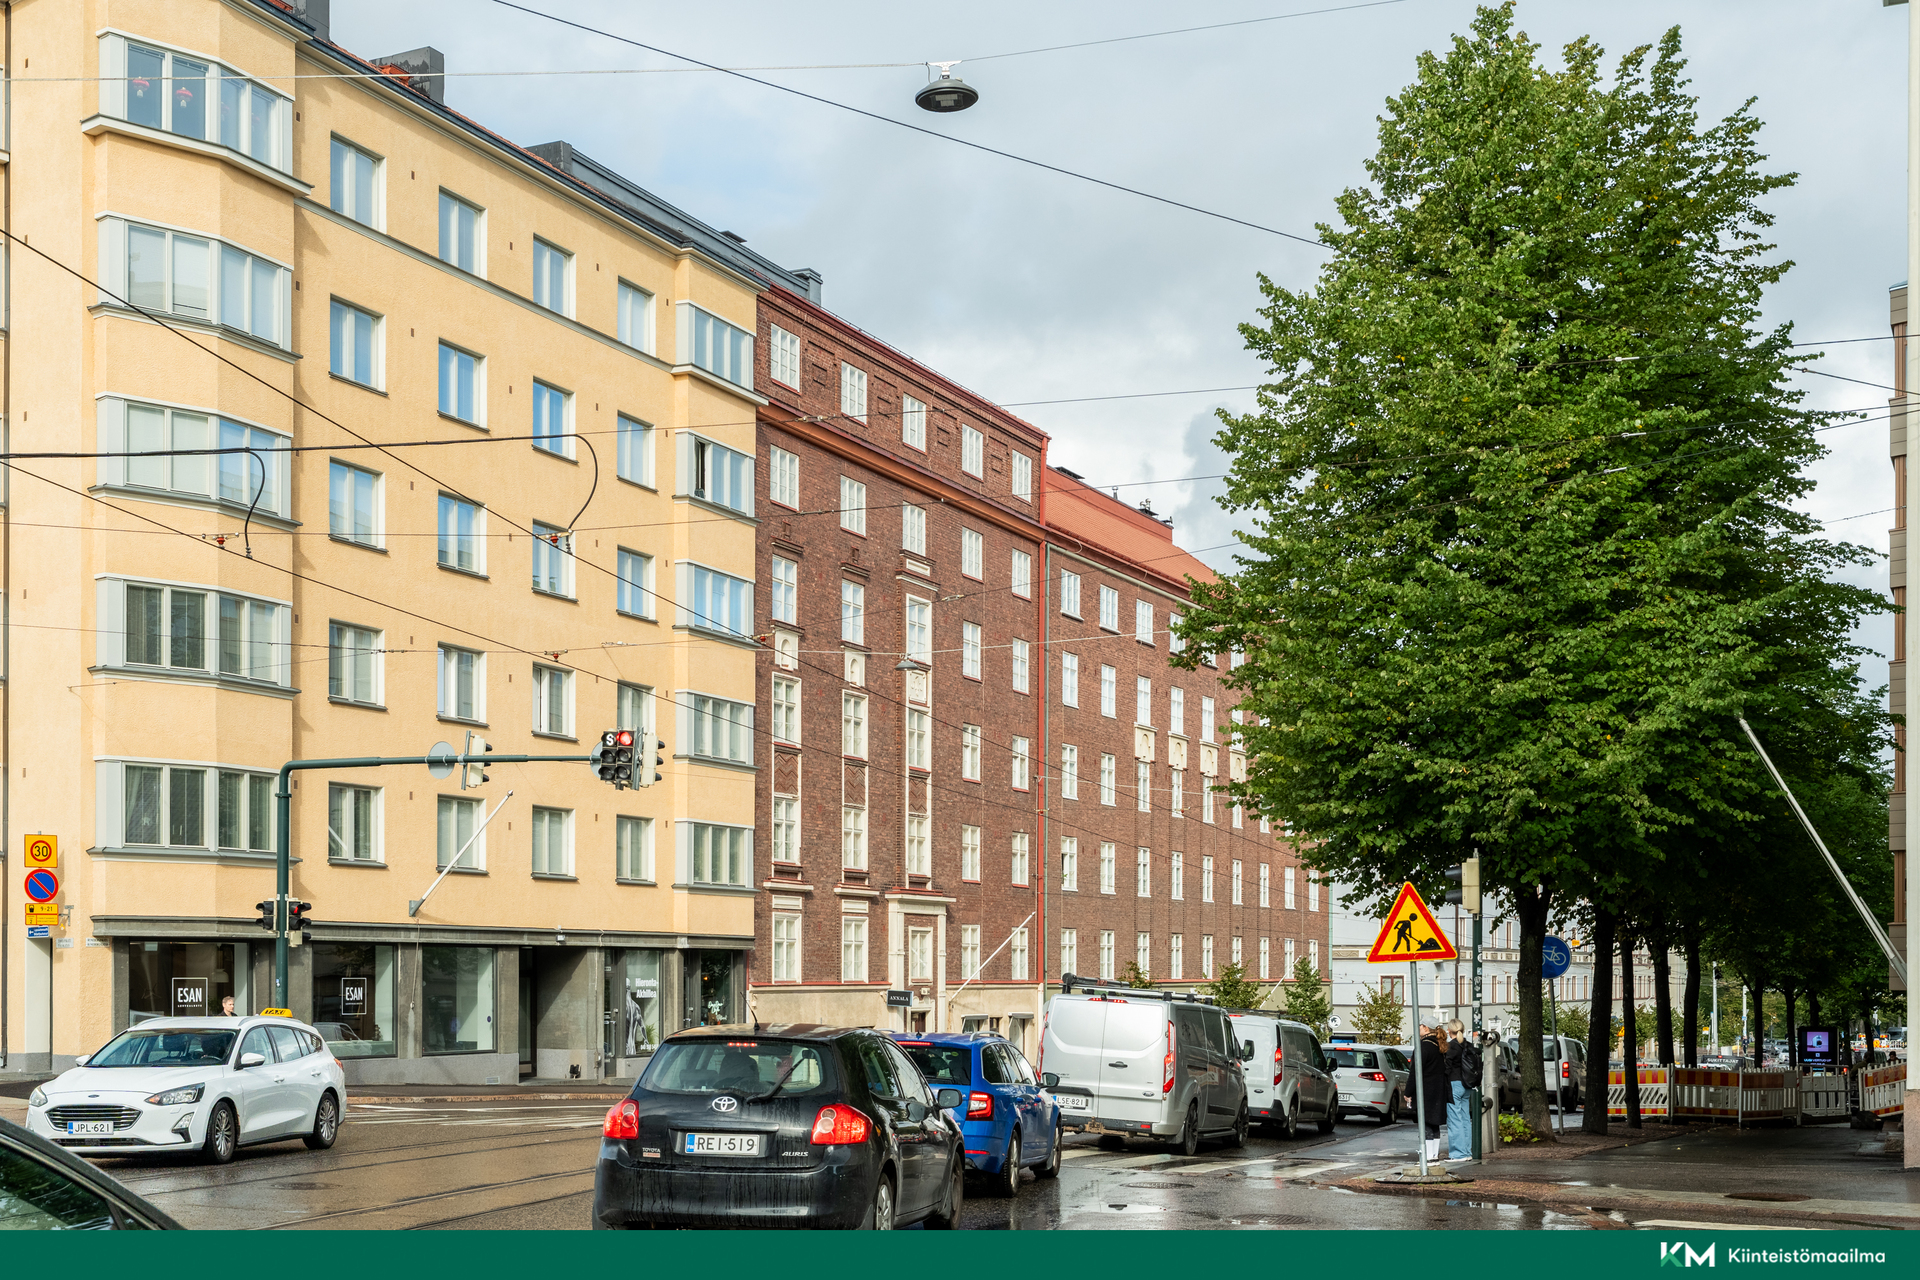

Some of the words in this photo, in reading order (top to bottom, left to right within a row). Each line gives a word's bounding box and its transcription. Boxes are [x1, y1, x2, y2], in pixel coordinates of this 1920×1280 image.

[606, 733, 615, 746] S
[34, 845, 49, 857] 30
[178, 988, 202, 1002] ESAN
[346, 987, 363, 1000] ESAN
[74, 1123, 110, 1133] JPL-621
[697, 1137, 755, 1152] REI-519
